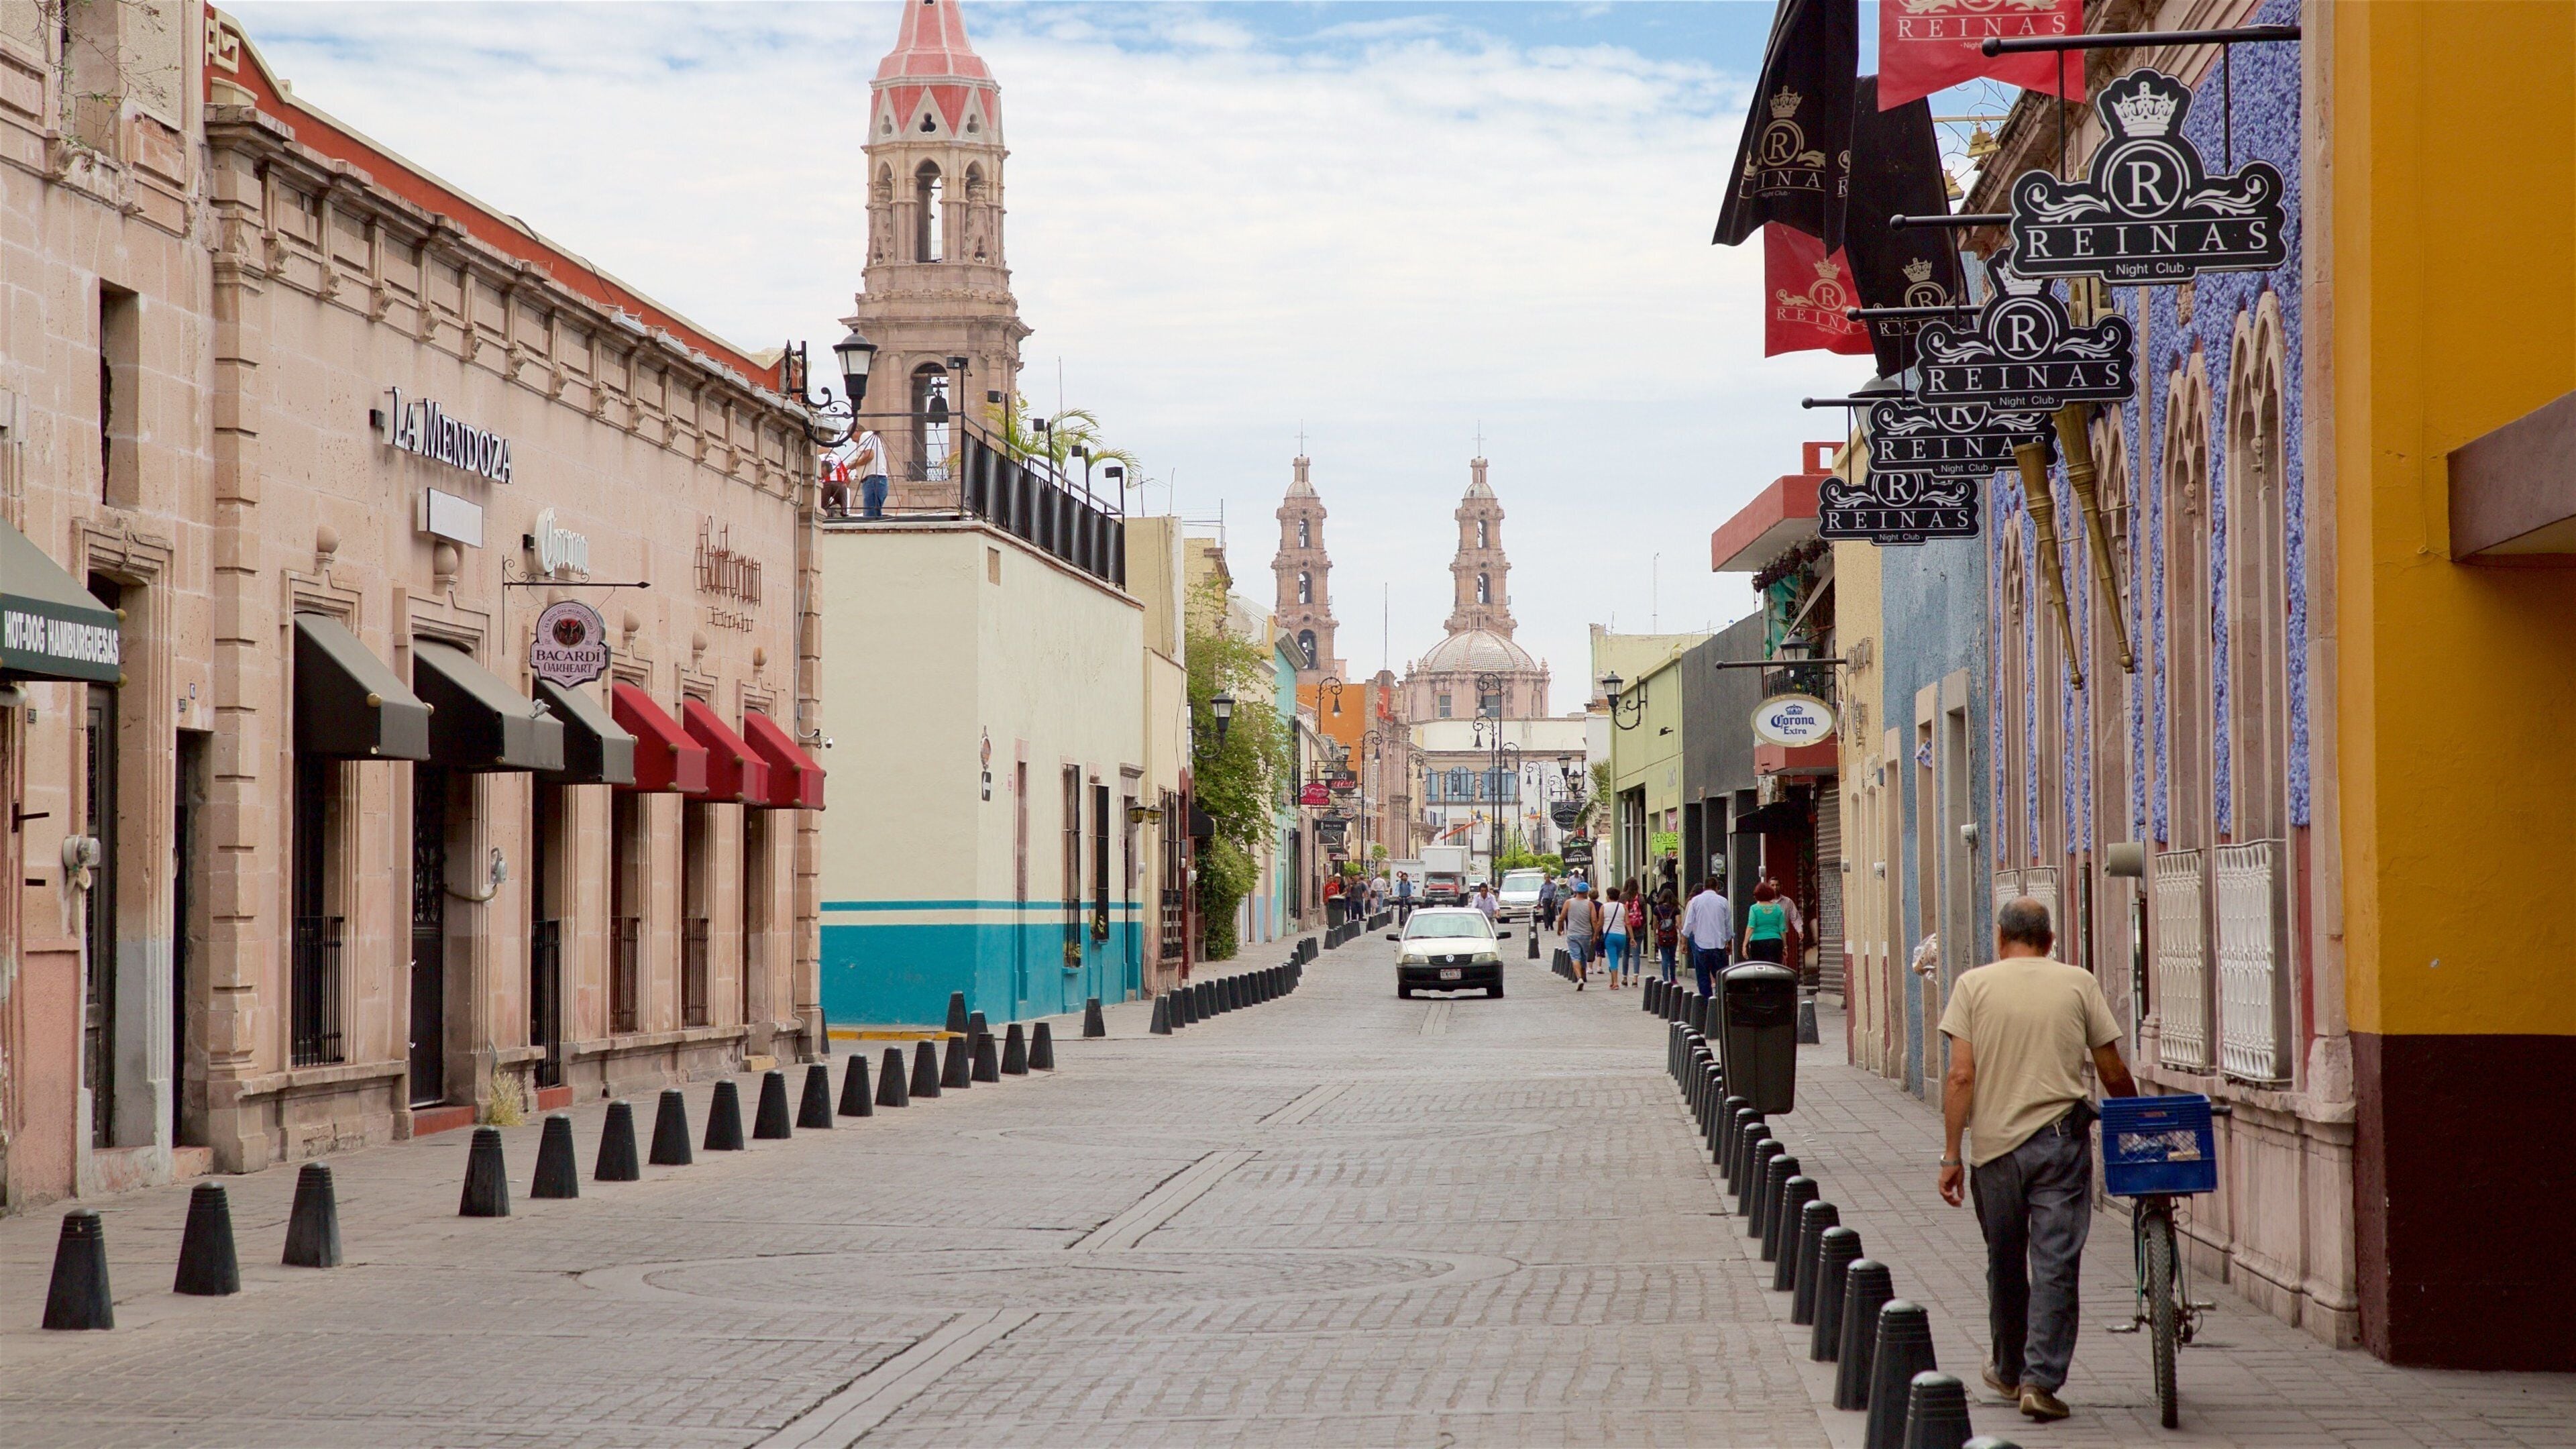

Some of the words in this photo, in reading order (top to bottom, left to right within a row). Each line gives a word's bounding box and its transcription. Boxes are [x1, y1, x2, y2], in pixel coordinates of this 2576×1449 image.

[1897, 15, 2066, 38] REINAS
[1768, 132, 1790, 160] R
[2126, 160, 2169, 207] R
[2026, 221, 2268, 258] REINAS
[2116, 263, 2149, 276] Night
[2155, 262, 2185, 273] Club
[1820, 286, 1835, 307] R
[2007, 315, 2041, 352] R
[1927, 363, 2121, 392] REINAS
[1999, 396, 2026, 408] Night
[2031, 395, 2054, 405] Club
[392, 386, 419, 452] LA
[423, 398, 513, 484] MENDOZA
[1941, 464, 1964, 474] Night
[1968, 464, 1989, 472] Club
[1886, 474, 1911, 500] R
[1827, 510, 1969, 529] REINAS
[1879, 534, 1898, 542] Night
[4, 610, 45, 653] HOT-DOG
[48, 619, 119, 665] HAMBURGUESAS
[543, 662, 593, 674] OAKHEART
[1770, 714, 1815, 729] Corona
[1784, 727, 1807, 735] Extra
